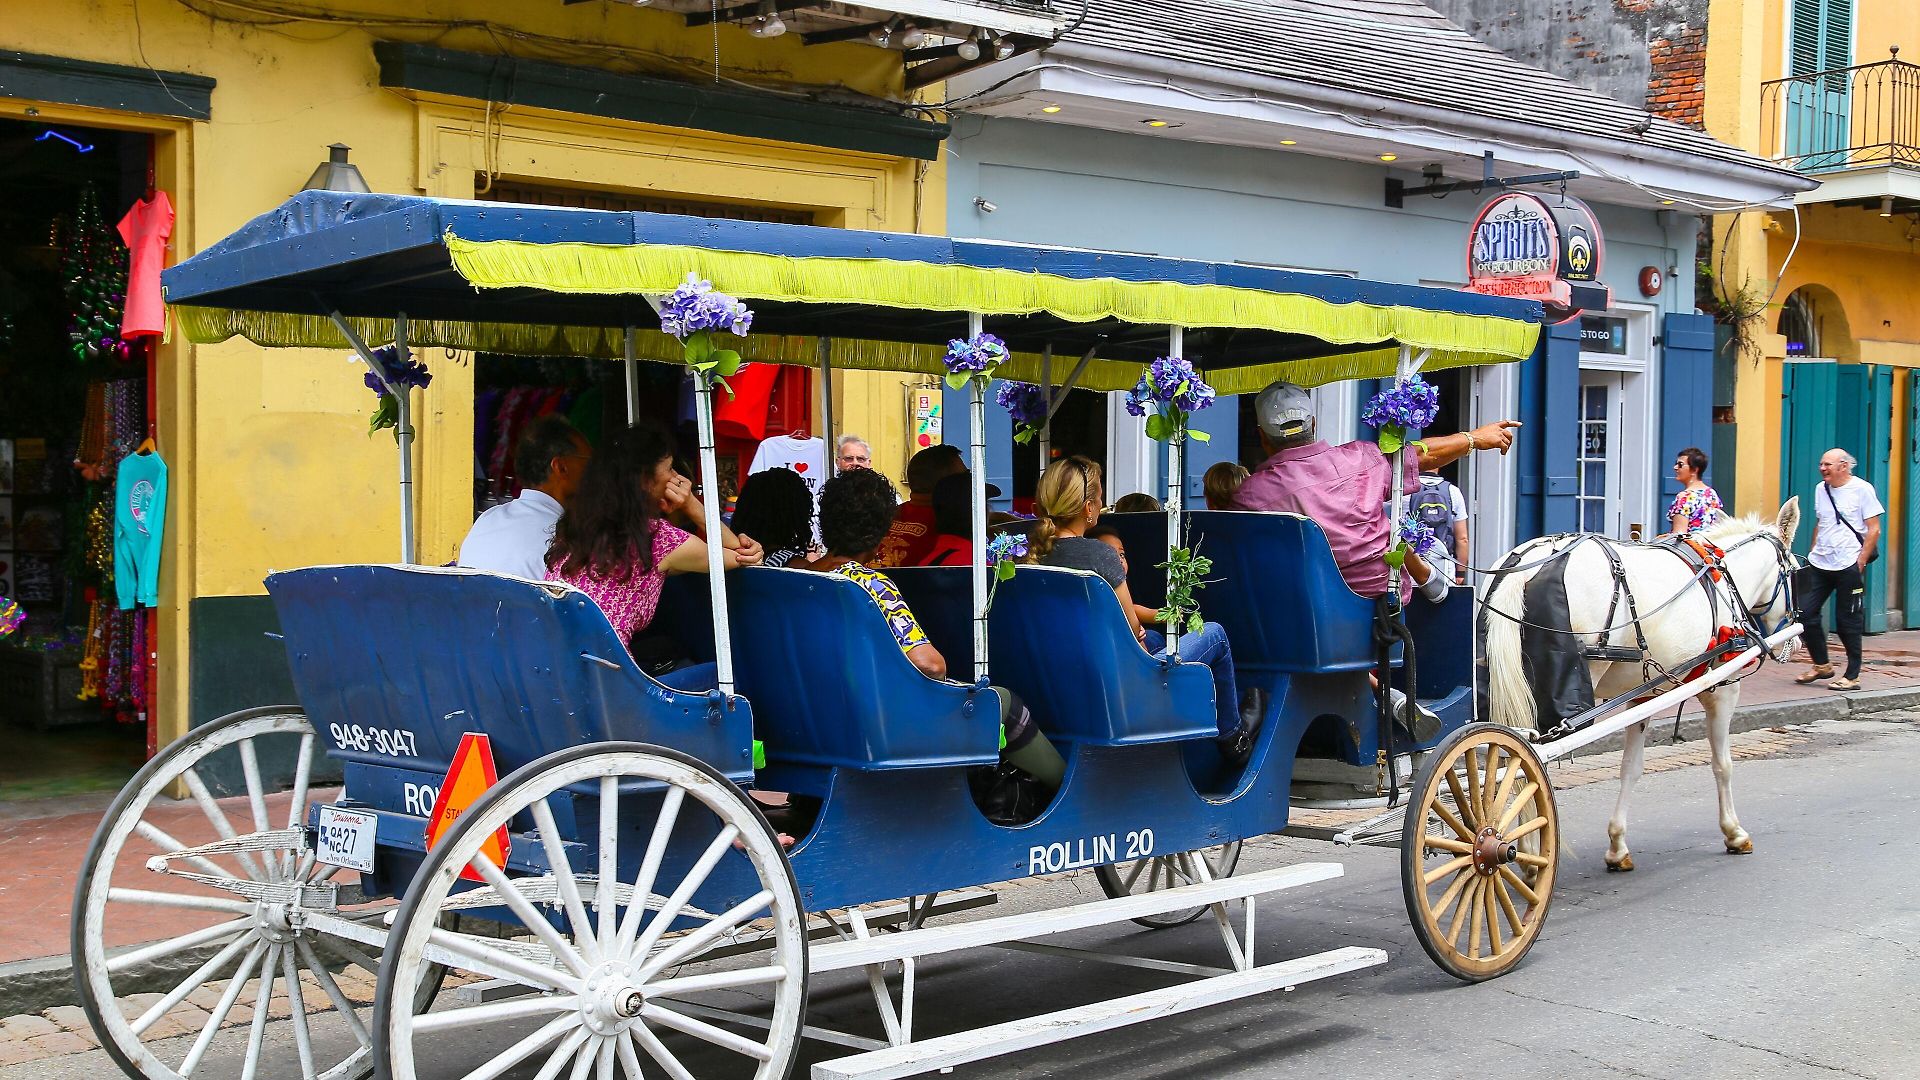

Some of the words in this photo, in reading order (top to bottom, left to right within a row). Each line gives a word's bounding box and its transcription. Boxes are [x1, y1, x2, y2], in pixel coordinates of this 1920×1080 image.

[1478, 218, 1550, 262] SPIRITS
[1491, 257, 1549, 275] BOURBON
[1587, 330, 1597, 339] TO
[1598, 331, 1610, 340] GO
[1585, 437, 1601, 449] GO
[329, 722, 418, 757] 948-3047
[446, 808, 463, 820] STA
[329, 840, 342, 854] NC
[330, 826, 342, 839] QA
[341, 827, 357, 855] 27
[329, 853, 340, 863] New
[340, 855, 360, 867] Orleans
[1028, 833, 1116, 876] ROLLIN
[1125, 828, 1154, 859] 20
